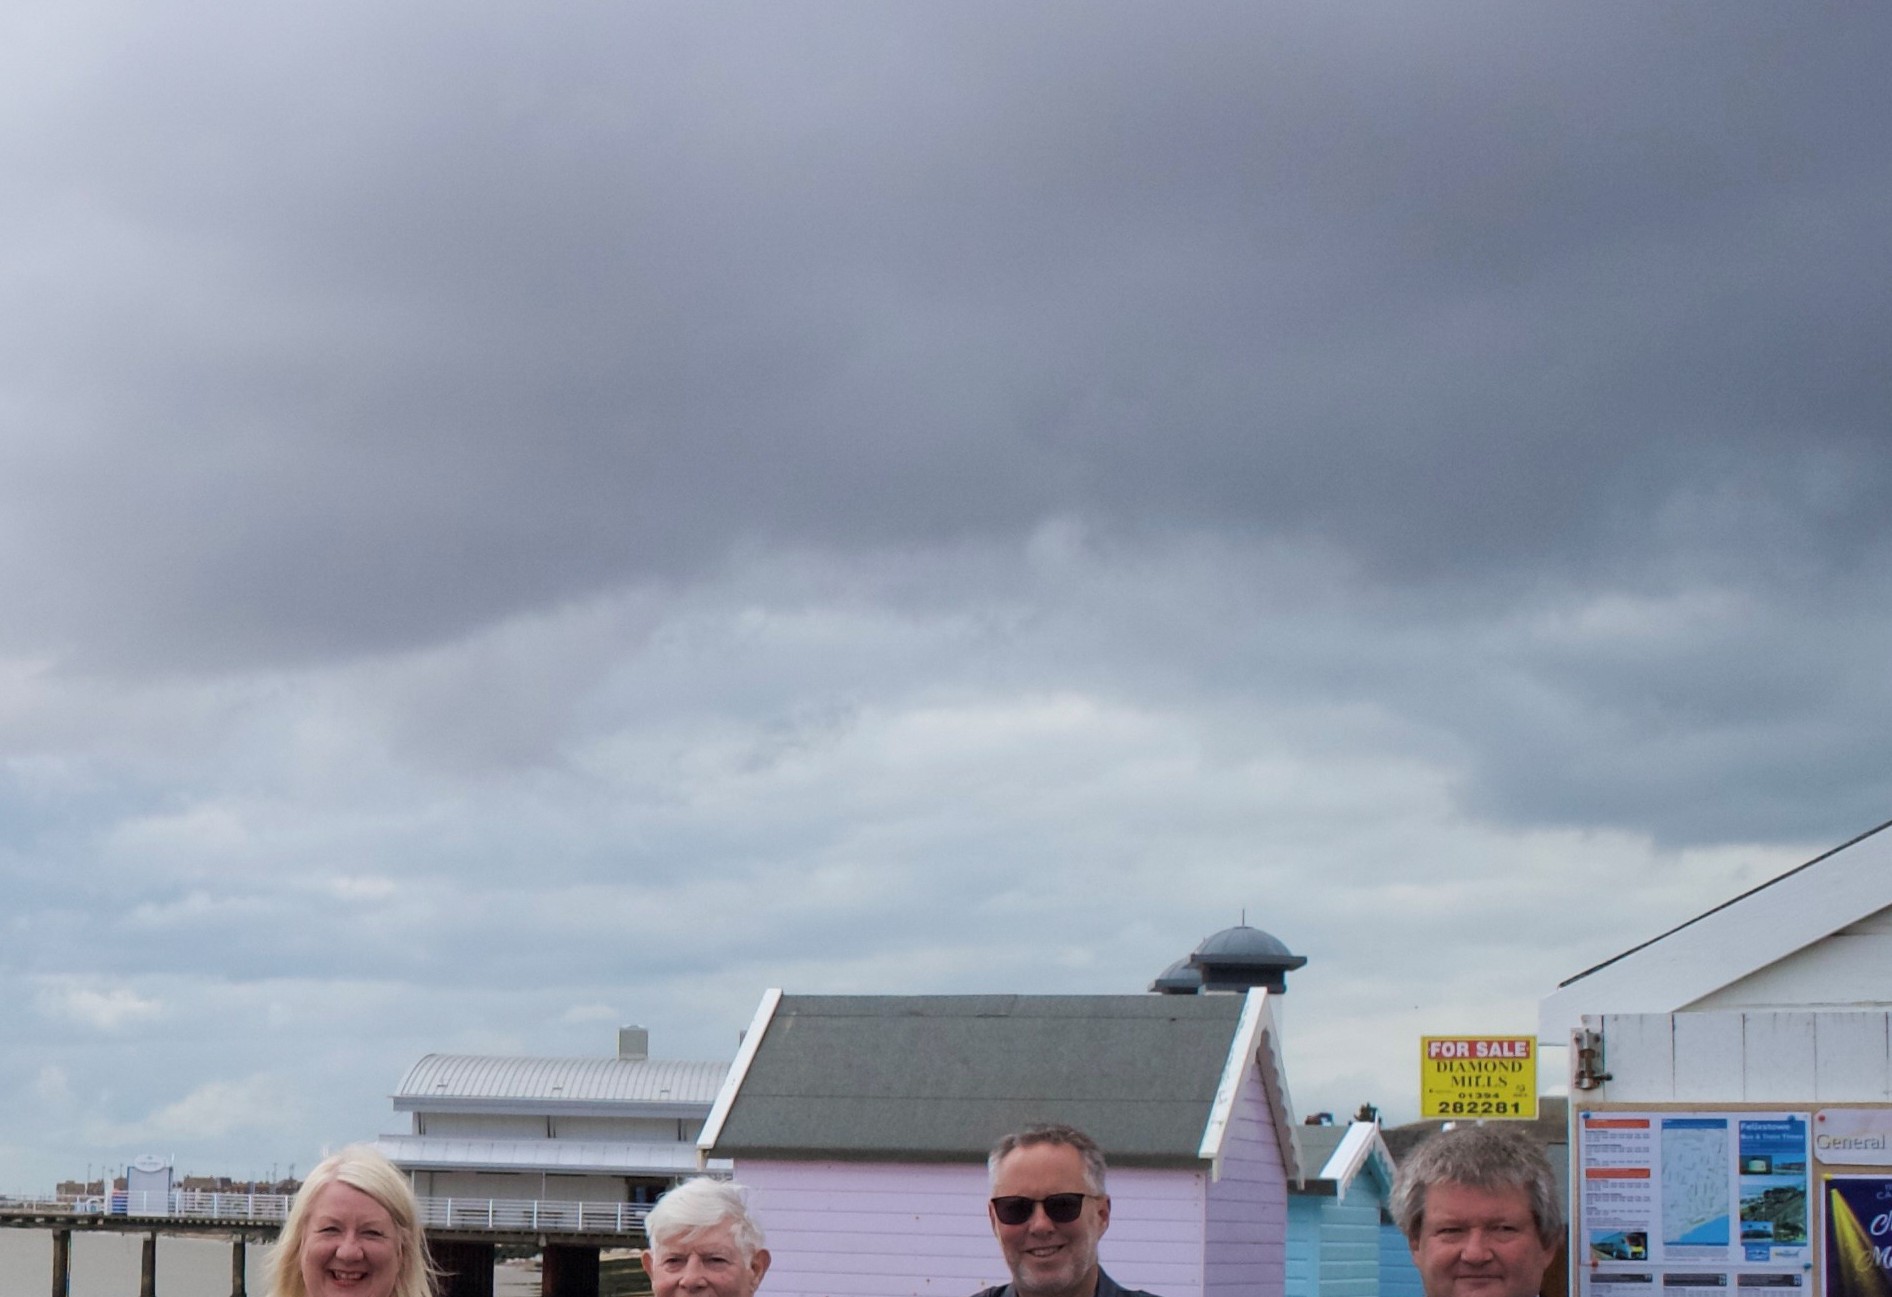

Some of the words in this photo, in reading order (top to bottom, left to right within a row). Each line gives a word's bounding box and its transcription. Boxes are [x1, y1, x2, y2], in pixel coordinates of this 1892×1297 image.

[1430, 1041, 1469, 1058] FOR
[1476, 1041, 1527, 1058] SALE
[1436, 1060, 1523, 1073] DIAMOND
[1451, 1075, 1508, 1087] MILLS
[1438, 1101, 1520, 1114] 282281
[1816, 1133, 1886, 1150] General
